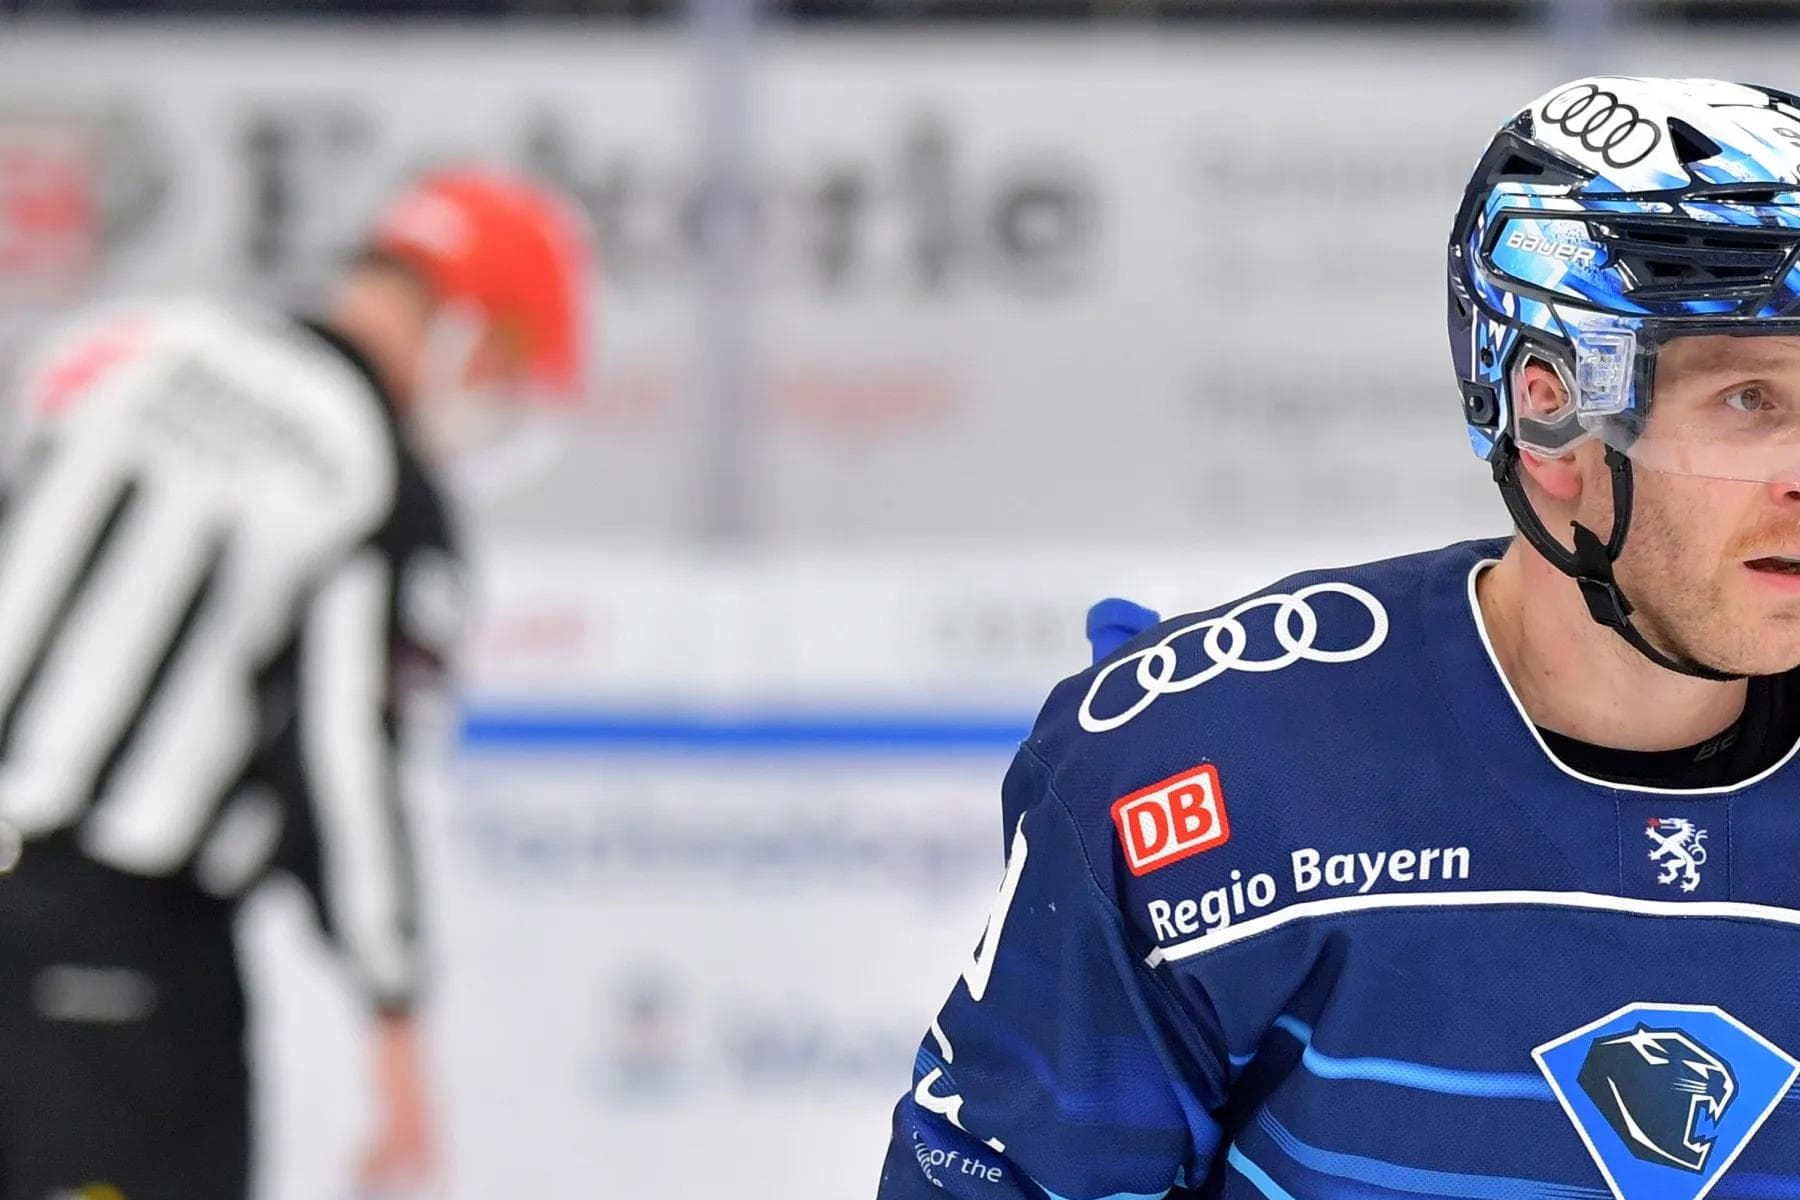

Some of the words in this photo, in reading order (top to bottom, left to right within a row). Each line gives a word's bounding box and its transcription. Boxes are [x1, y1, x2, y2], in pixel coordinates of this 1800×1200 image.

[1127, 782, 1213, 861] DB
[1146, 870, 1276, 941] Regio
[1291, 846, 1471, 893] Bayern
[929, 1149, 958, 1168] of
[961, 1158, 1003, 1183] the
